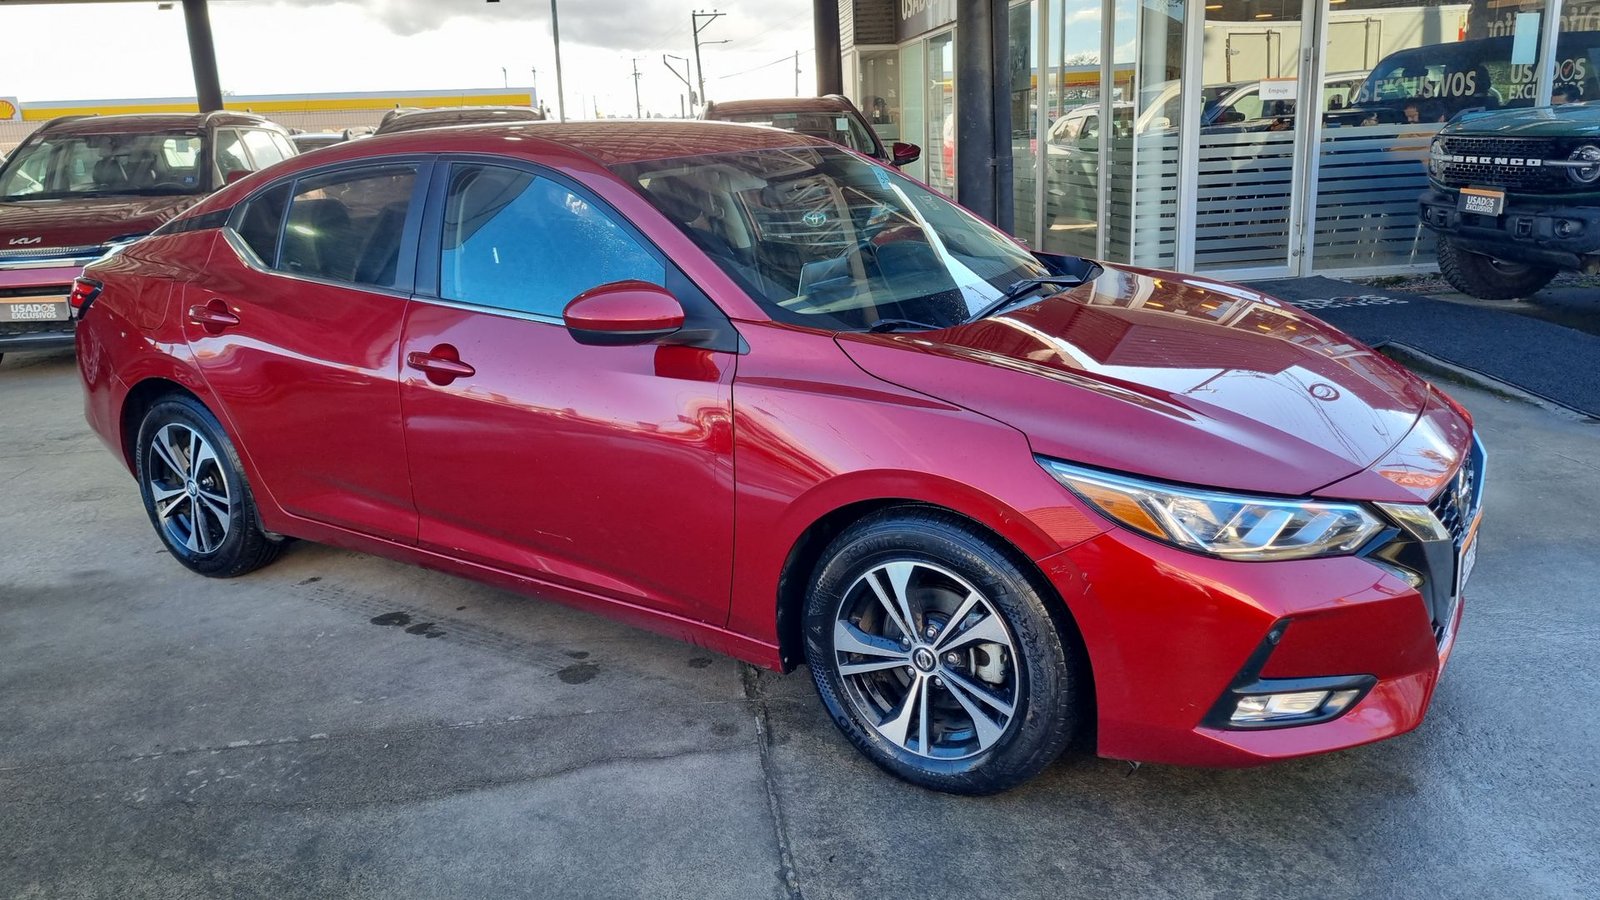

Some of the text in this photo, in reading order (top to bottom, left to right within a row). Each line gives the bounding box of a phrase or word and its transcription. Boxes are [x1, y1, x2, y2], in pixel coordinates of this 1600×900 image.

[901, 0, 937, 20] USAD
[1453, 155, 1541, 166] BRONCO
[1466, 195, 1495, 207] USADOS
[1465, 203, 1494, 213] EXCLUSIVOS
[10, 303, 56, 313] USADOS
[11, 312, 57, 320] EXCLUSIVOS
